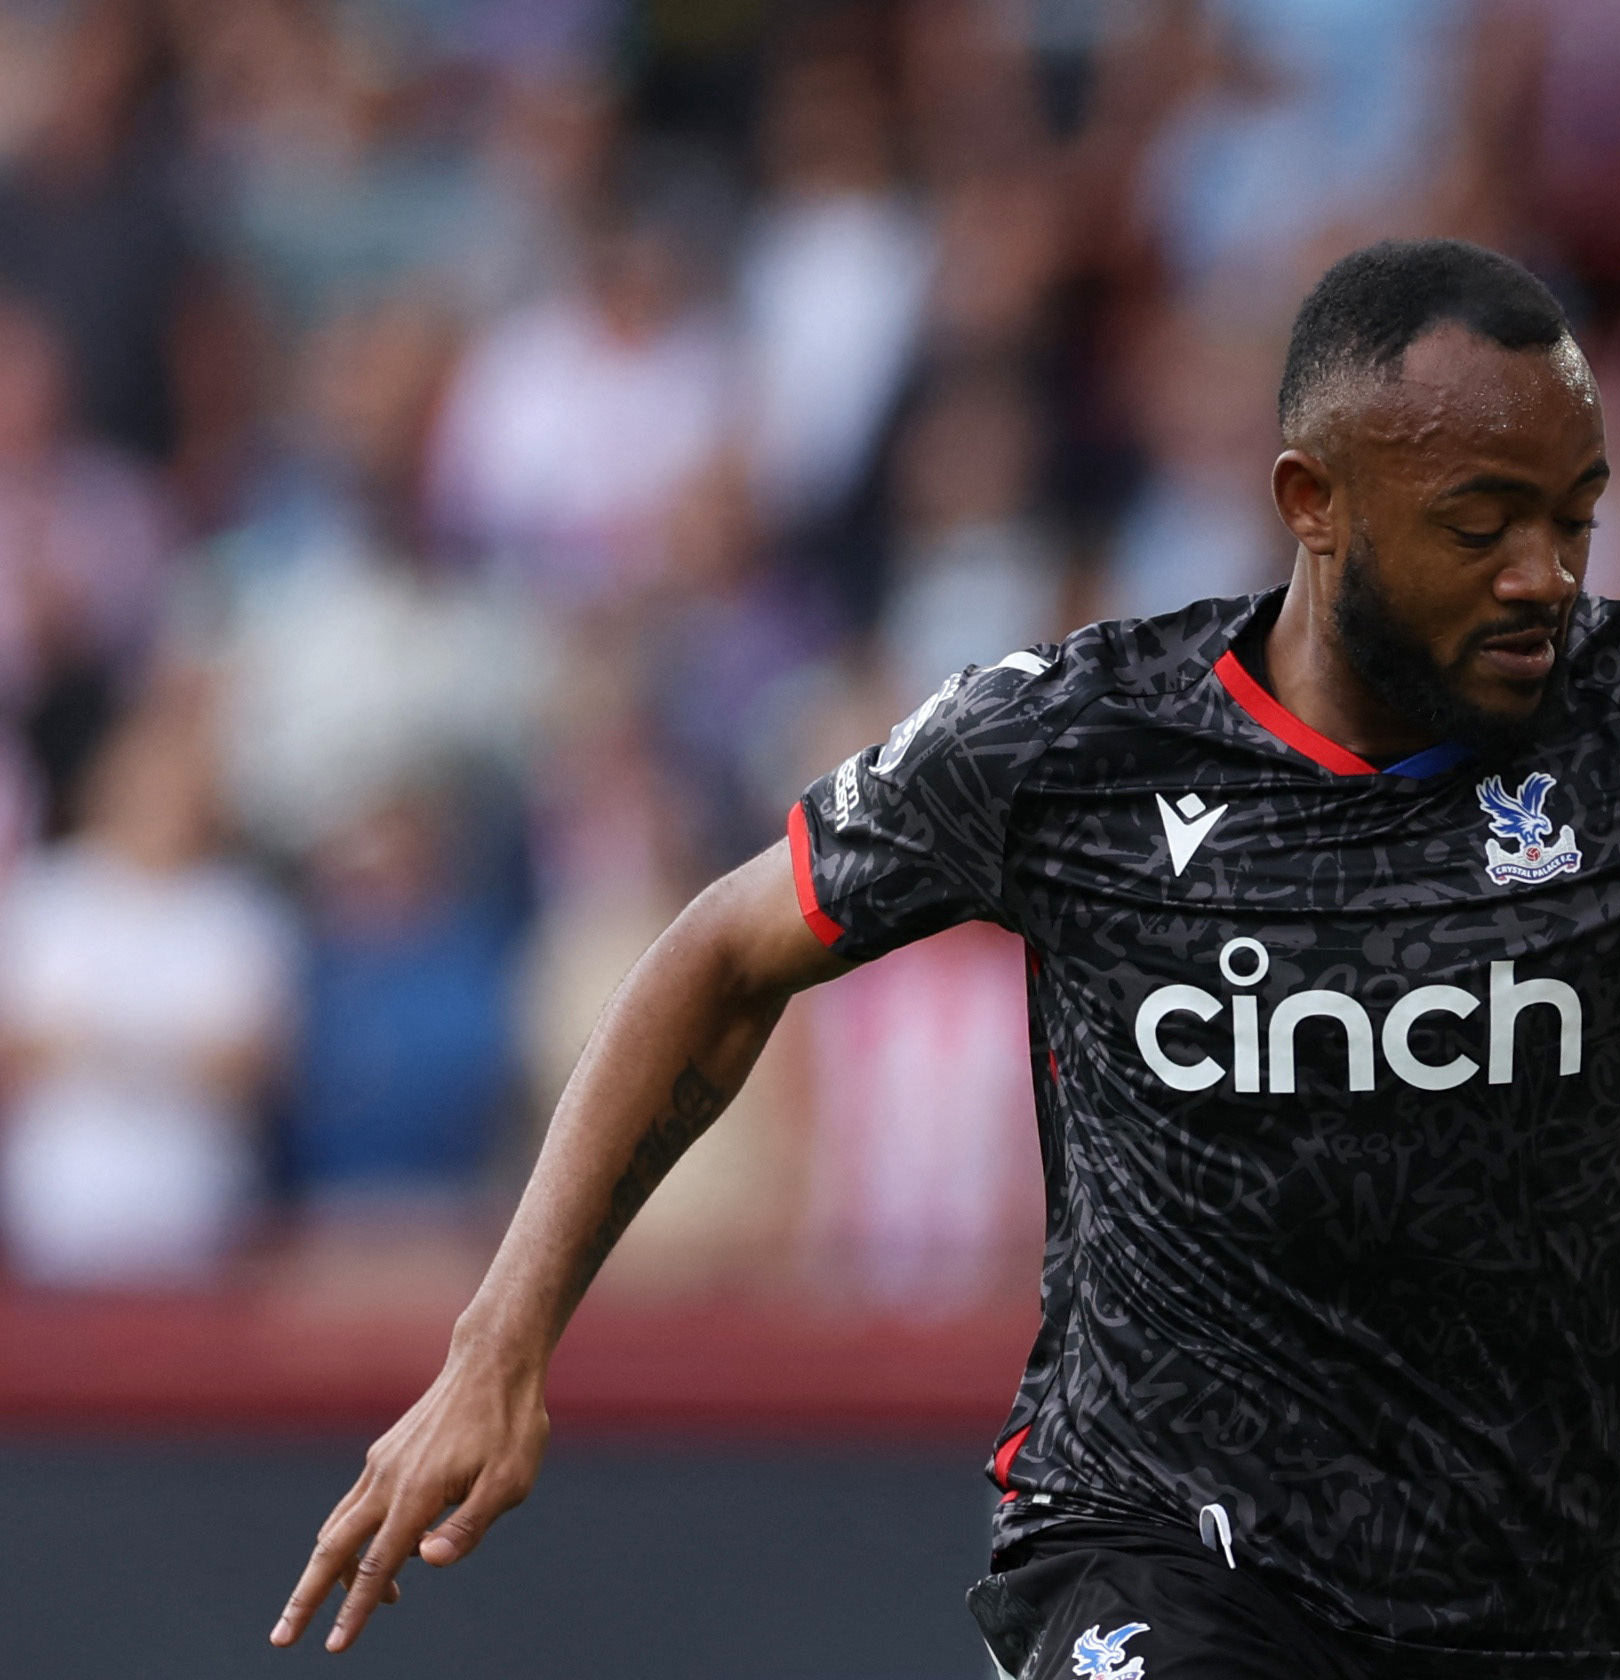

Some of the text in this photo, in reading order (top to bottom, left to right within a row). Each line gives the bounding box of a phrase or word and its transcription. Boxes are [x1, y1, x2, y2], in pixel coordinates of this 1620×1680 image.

[1495, 866, 1532, 878] CRYSTAL
[1533, 858, 1561, 878] PALACE
[1135, 936, 1582, 1093] cinch
